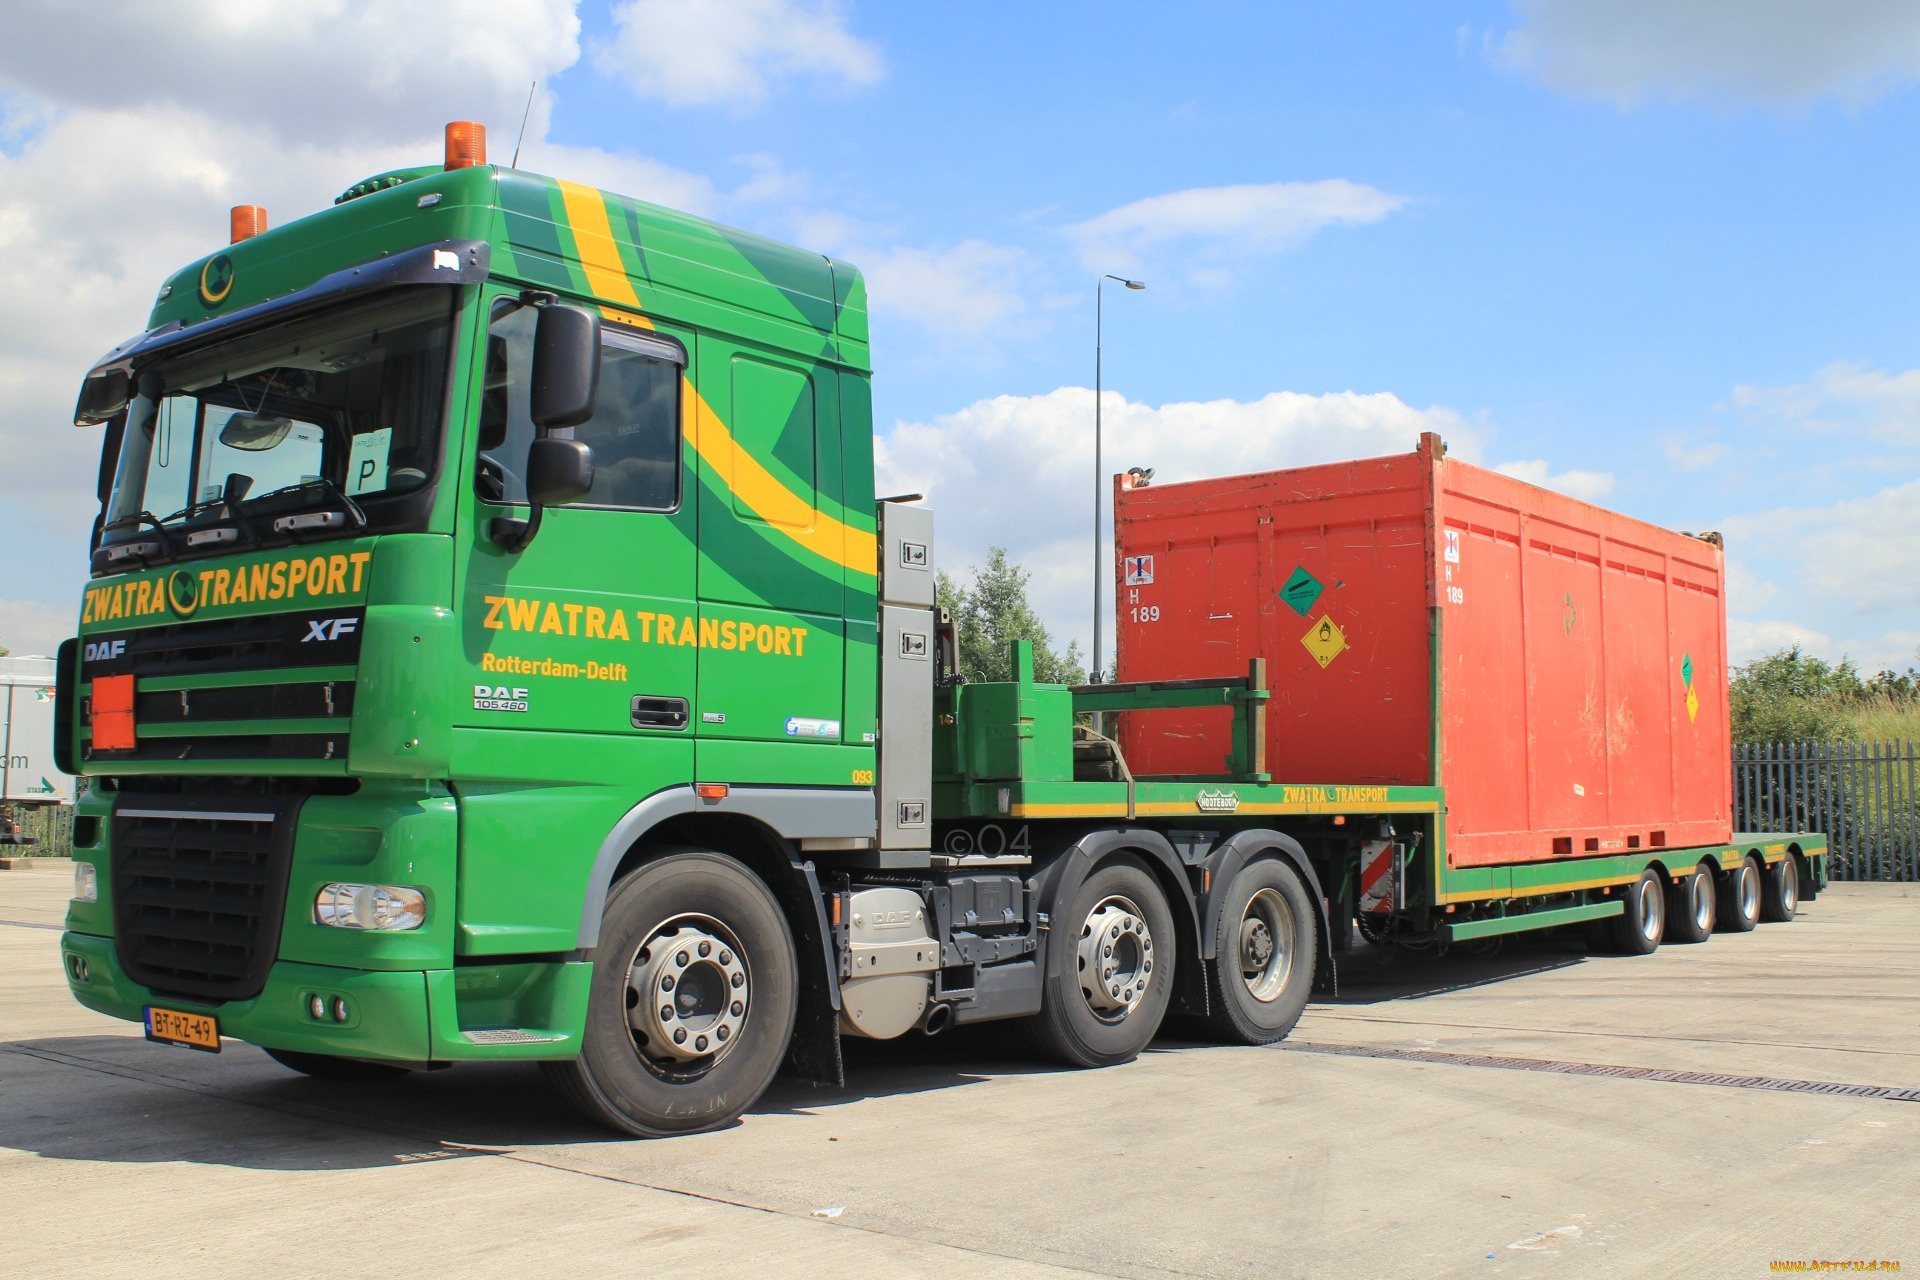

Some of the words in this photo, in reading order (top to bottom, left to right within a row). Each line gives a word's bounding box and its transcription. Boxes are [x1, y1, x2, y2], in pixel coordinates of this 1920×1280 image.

[358, 459, 376, 491] P
[1446, 564, 1452, 583] H
[82, 578, 165, 624] ZWATRA
[199, 552, 370, 607] TRANSPORT
[1129, 588, 1139, 605] H
[1447, 585, 1463, 605] 189
[1130, 605, 1160, 623] 189
[300, 618, 359, 642] XF
[483, 595, 629, 641] ZWATRA
[637, 612, 808, 657] TRANSPORT
[84, 640, 126, 662] DAF
[482, 653, 627, 682] Rotterdam-Delft
[474, 685, 528, 699] DAF
[475, 700, 526, 711] 105.460
[852, 769, 873, 784] 093
[1283, 786, 1326, 803] ZWATRA
[1335, 786, 1389, 802] TRANSPORT
[872, 911, 911, 924] DAF
[155, 1012, 210, 1041] BT-RZ-49
